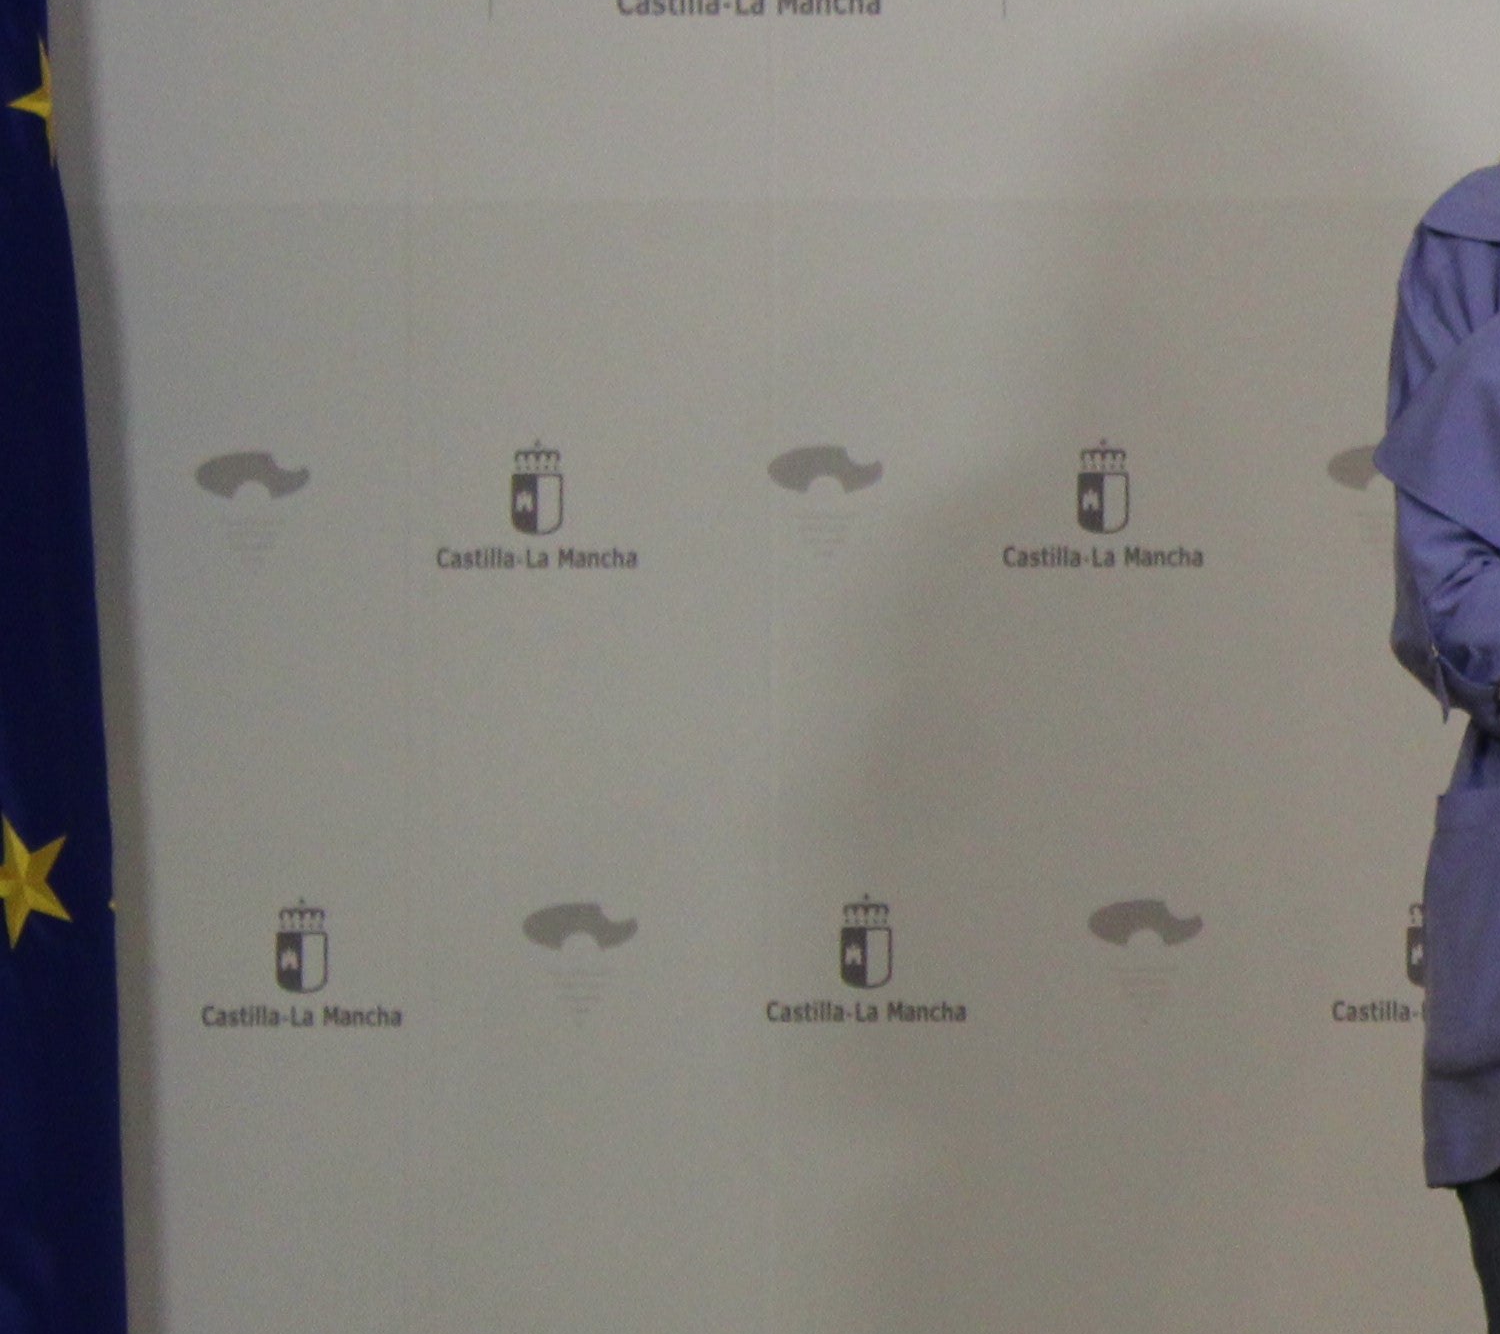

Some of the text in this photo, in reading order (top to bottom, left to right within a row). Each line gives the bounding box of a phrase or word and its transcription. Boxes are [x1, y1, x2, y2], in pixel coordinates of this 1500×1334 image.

[435, 546, 638, 570] Castilla-La Mancha
[1002, 544, 1204, 569] Castilla-La Mancha
[200, 1004, 403, 1028] Castilla-La Mancha
[766, 1000, 968, 1023] Castilla-La Mancha
